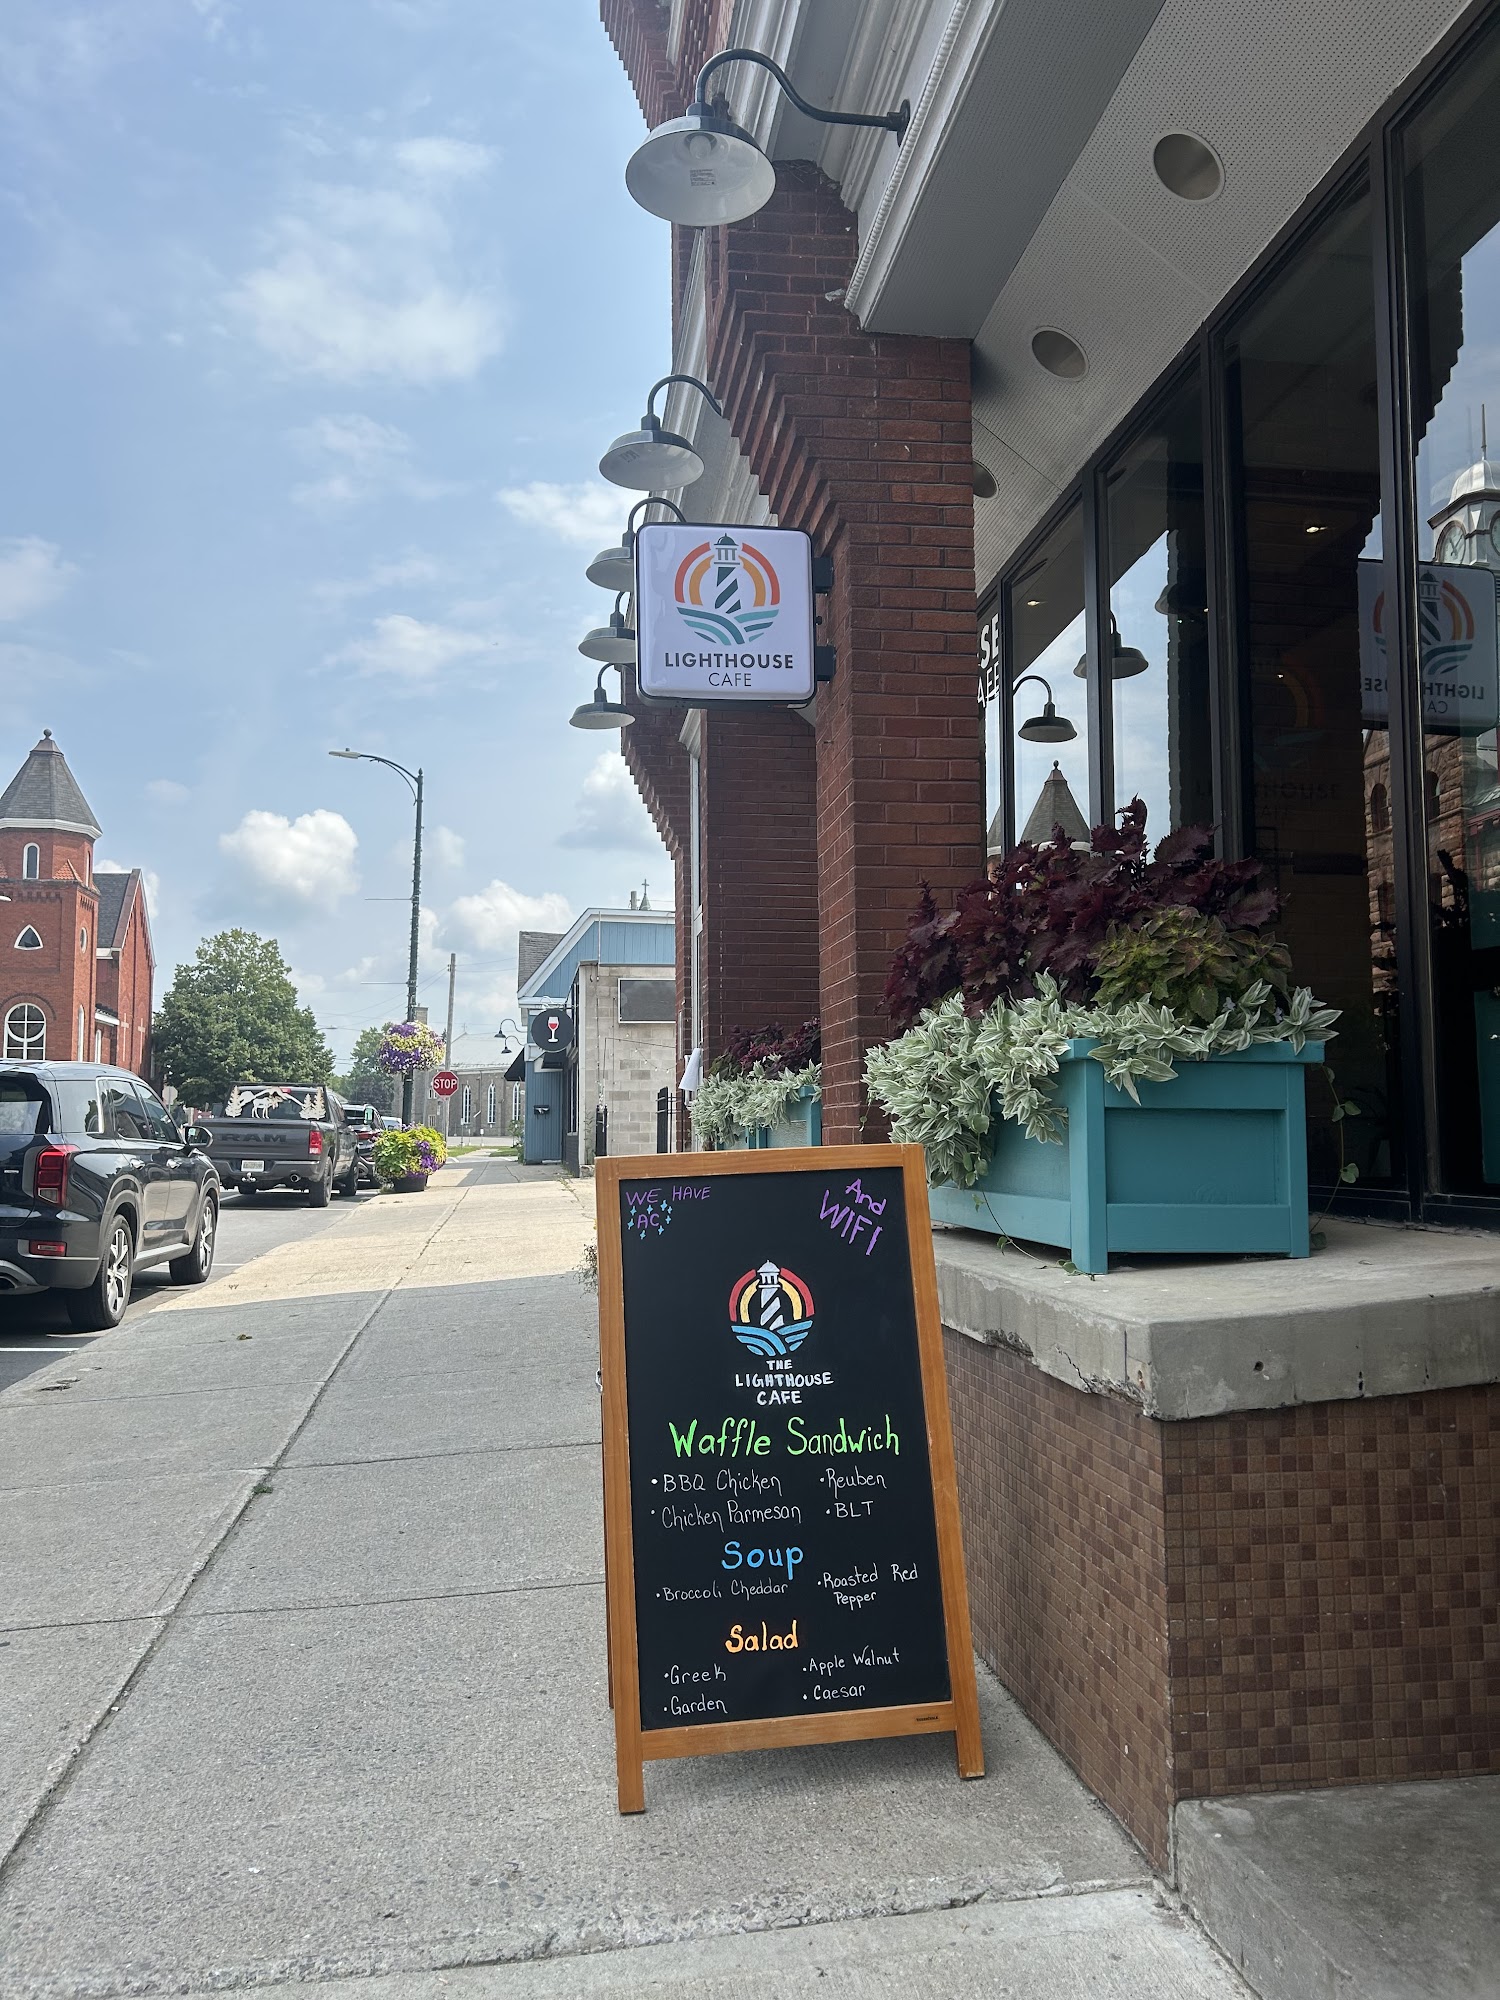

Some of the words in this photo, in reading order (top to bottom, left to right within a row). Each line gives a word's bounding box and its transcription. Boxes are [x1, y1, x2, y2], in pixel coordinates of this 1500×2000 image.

[665, 653, 793, 669] LIGHTHOUSE
[709, 673, 751, 686] CAFE
[434, 1078, 457, 1089] STOP
[221, 1133, 287, 1143] RAM
[626, 1189, 661, 1205] WE
[673, 1186, 711, 1201] HAVE
[845, 1178, 886, 1215] And
[637, 1213, 660, 1229] AC
[819, 1189, 883, 1256] WIFI
[766, 1359, 792, 1370] THE
[736, 1372, 834, 1387] LIGHTHOUSE
[757, 1390, 802, 1405] CAFE
[669, 1417, 771, 1457] Waffle
[787, 1414, 899, 1456] Sandwich
[664, 1474, 706, 1492] BBQ
[717, 1469, 782, 1497] Chicken
[826, 1466, 887, 1499] Reuben
[662, 1504, 724, 1533] Chicken
[834, 1501, 873, 1518] BLT
[722, 1541, 803, 1580] Soup
[823, 1563, 878, 1588] Roasted
[891, 1563, 918, 1582] Red
[663, 1581, 722, 1601] Broccoli
[731, 1580, 788, 1600] Cheddar
[833, 1592, 876, 1610] Pepper
[725, 1620, 798, 1653] Salad
[810, 1655, 845, 1676] Apple
[853, 1645, 899, 1666] Walnut
[671, 1664, 726, 1684] Greek
[814, 1685, 865, 1700] Caesar
[671, 1694, 728, 1715] Garden
